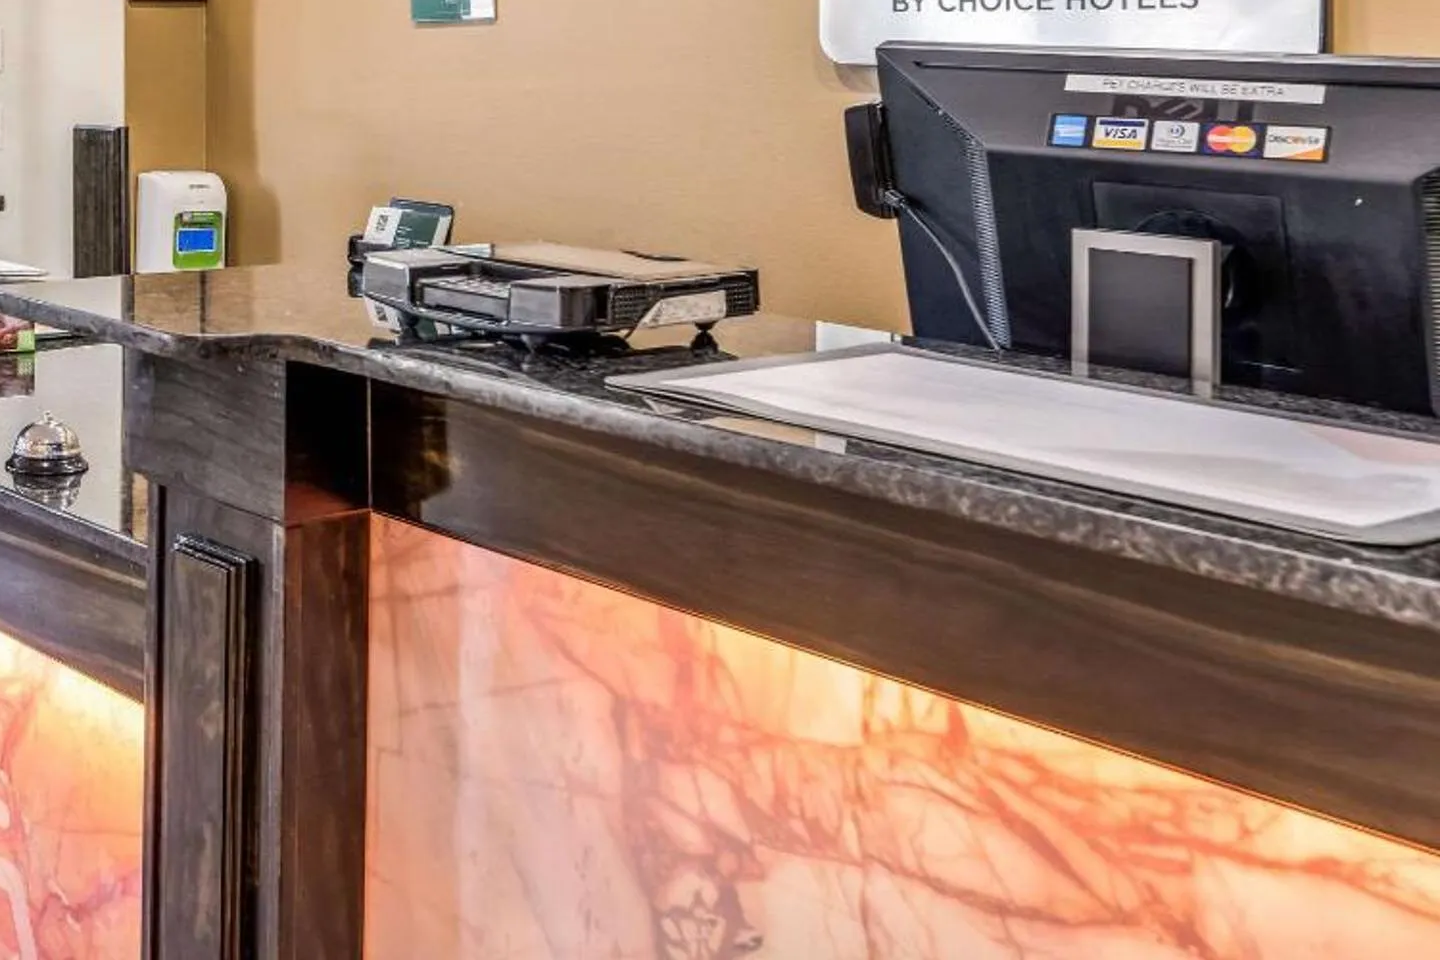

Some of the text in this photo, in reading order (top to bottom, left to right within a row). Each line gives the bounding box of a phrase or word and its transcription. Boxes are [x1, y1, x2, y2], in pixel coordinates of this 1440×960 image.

[1189, 82, 1218, 96] WILL
[1221, 83, 1239, 96] BE
[1240, 85, 1284, 97] EXTRA
[1102, 127, 1138, 140] VISA
